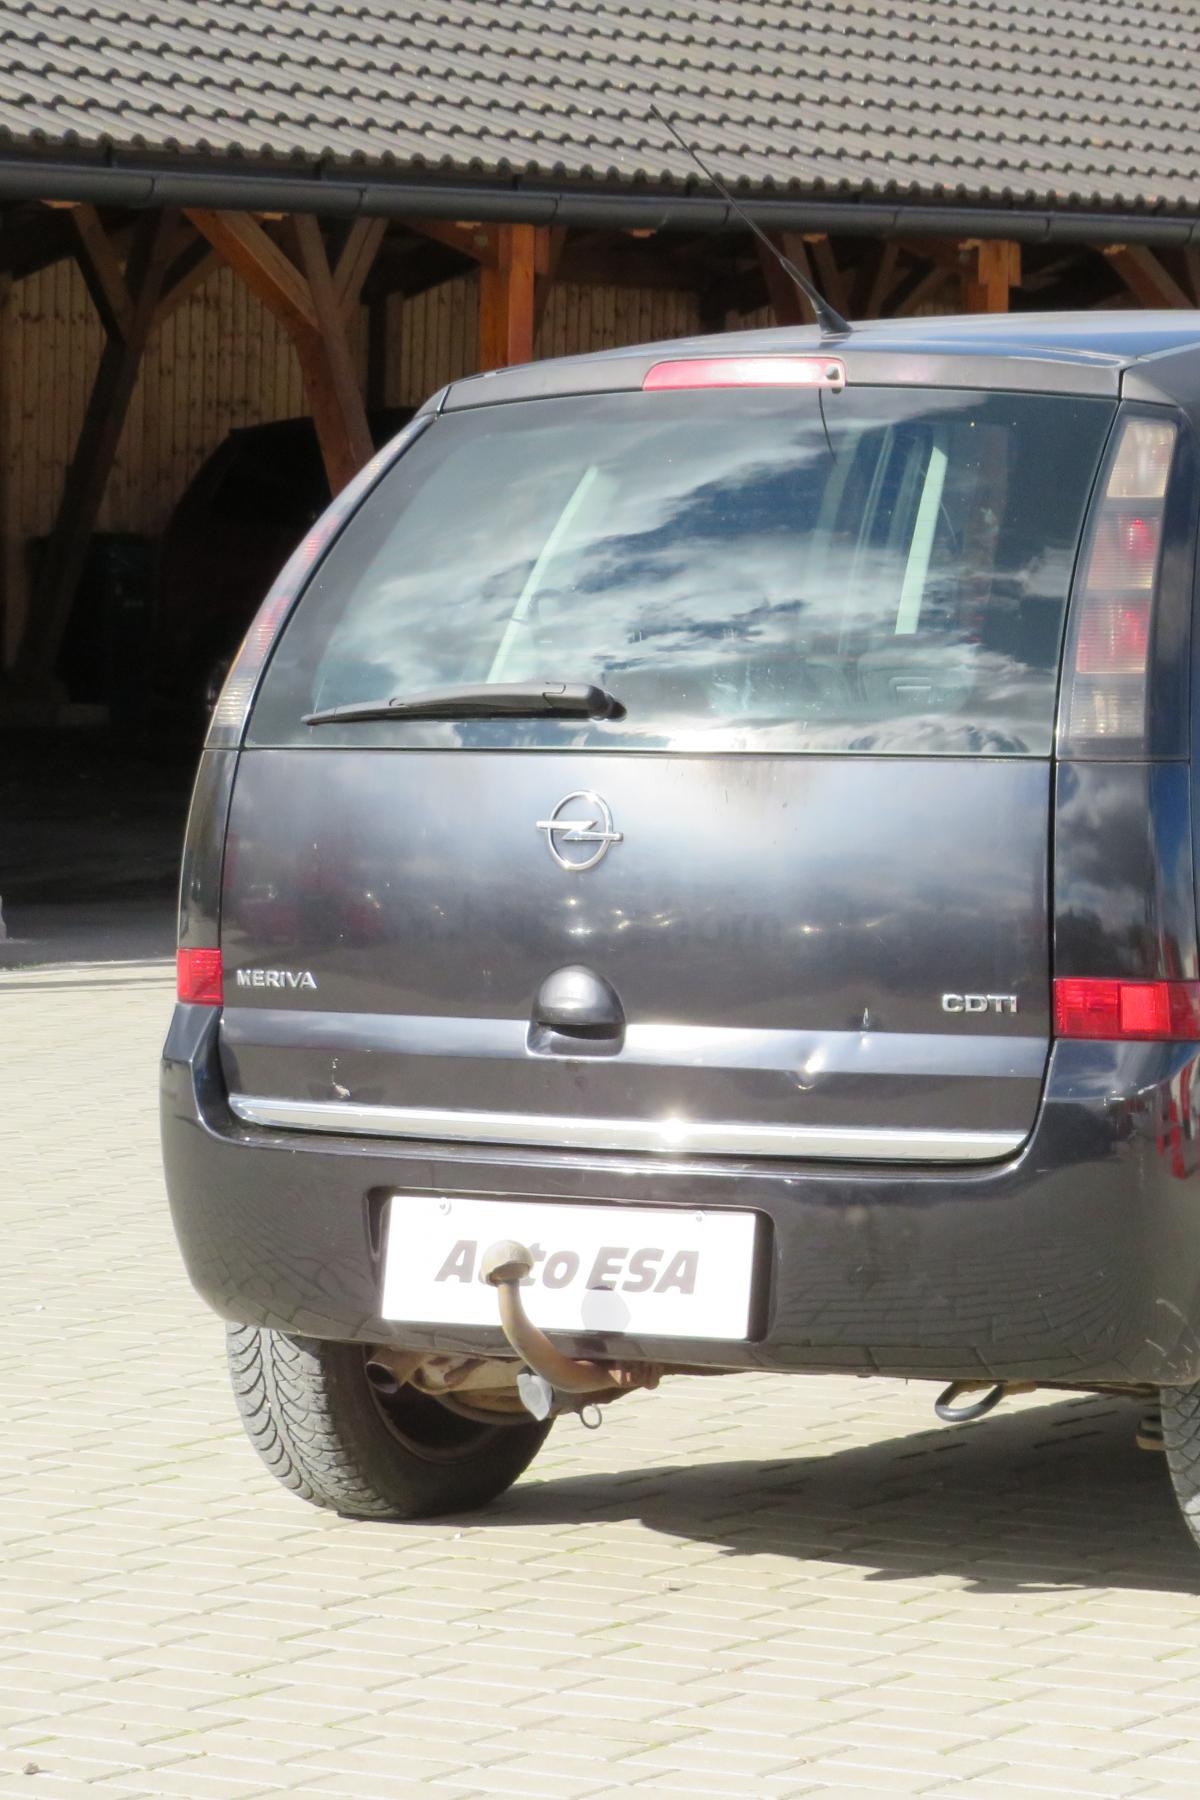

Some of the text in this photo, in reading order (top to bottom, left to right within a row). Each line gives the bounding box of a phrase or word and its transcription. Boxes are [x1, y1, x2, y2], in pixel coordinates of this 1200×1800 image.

[236, 969, 317, 989] MERIVA
[942, 993, 1017, 1012] CDTI
[434, 1239, 699, 1295] Ato ESA
